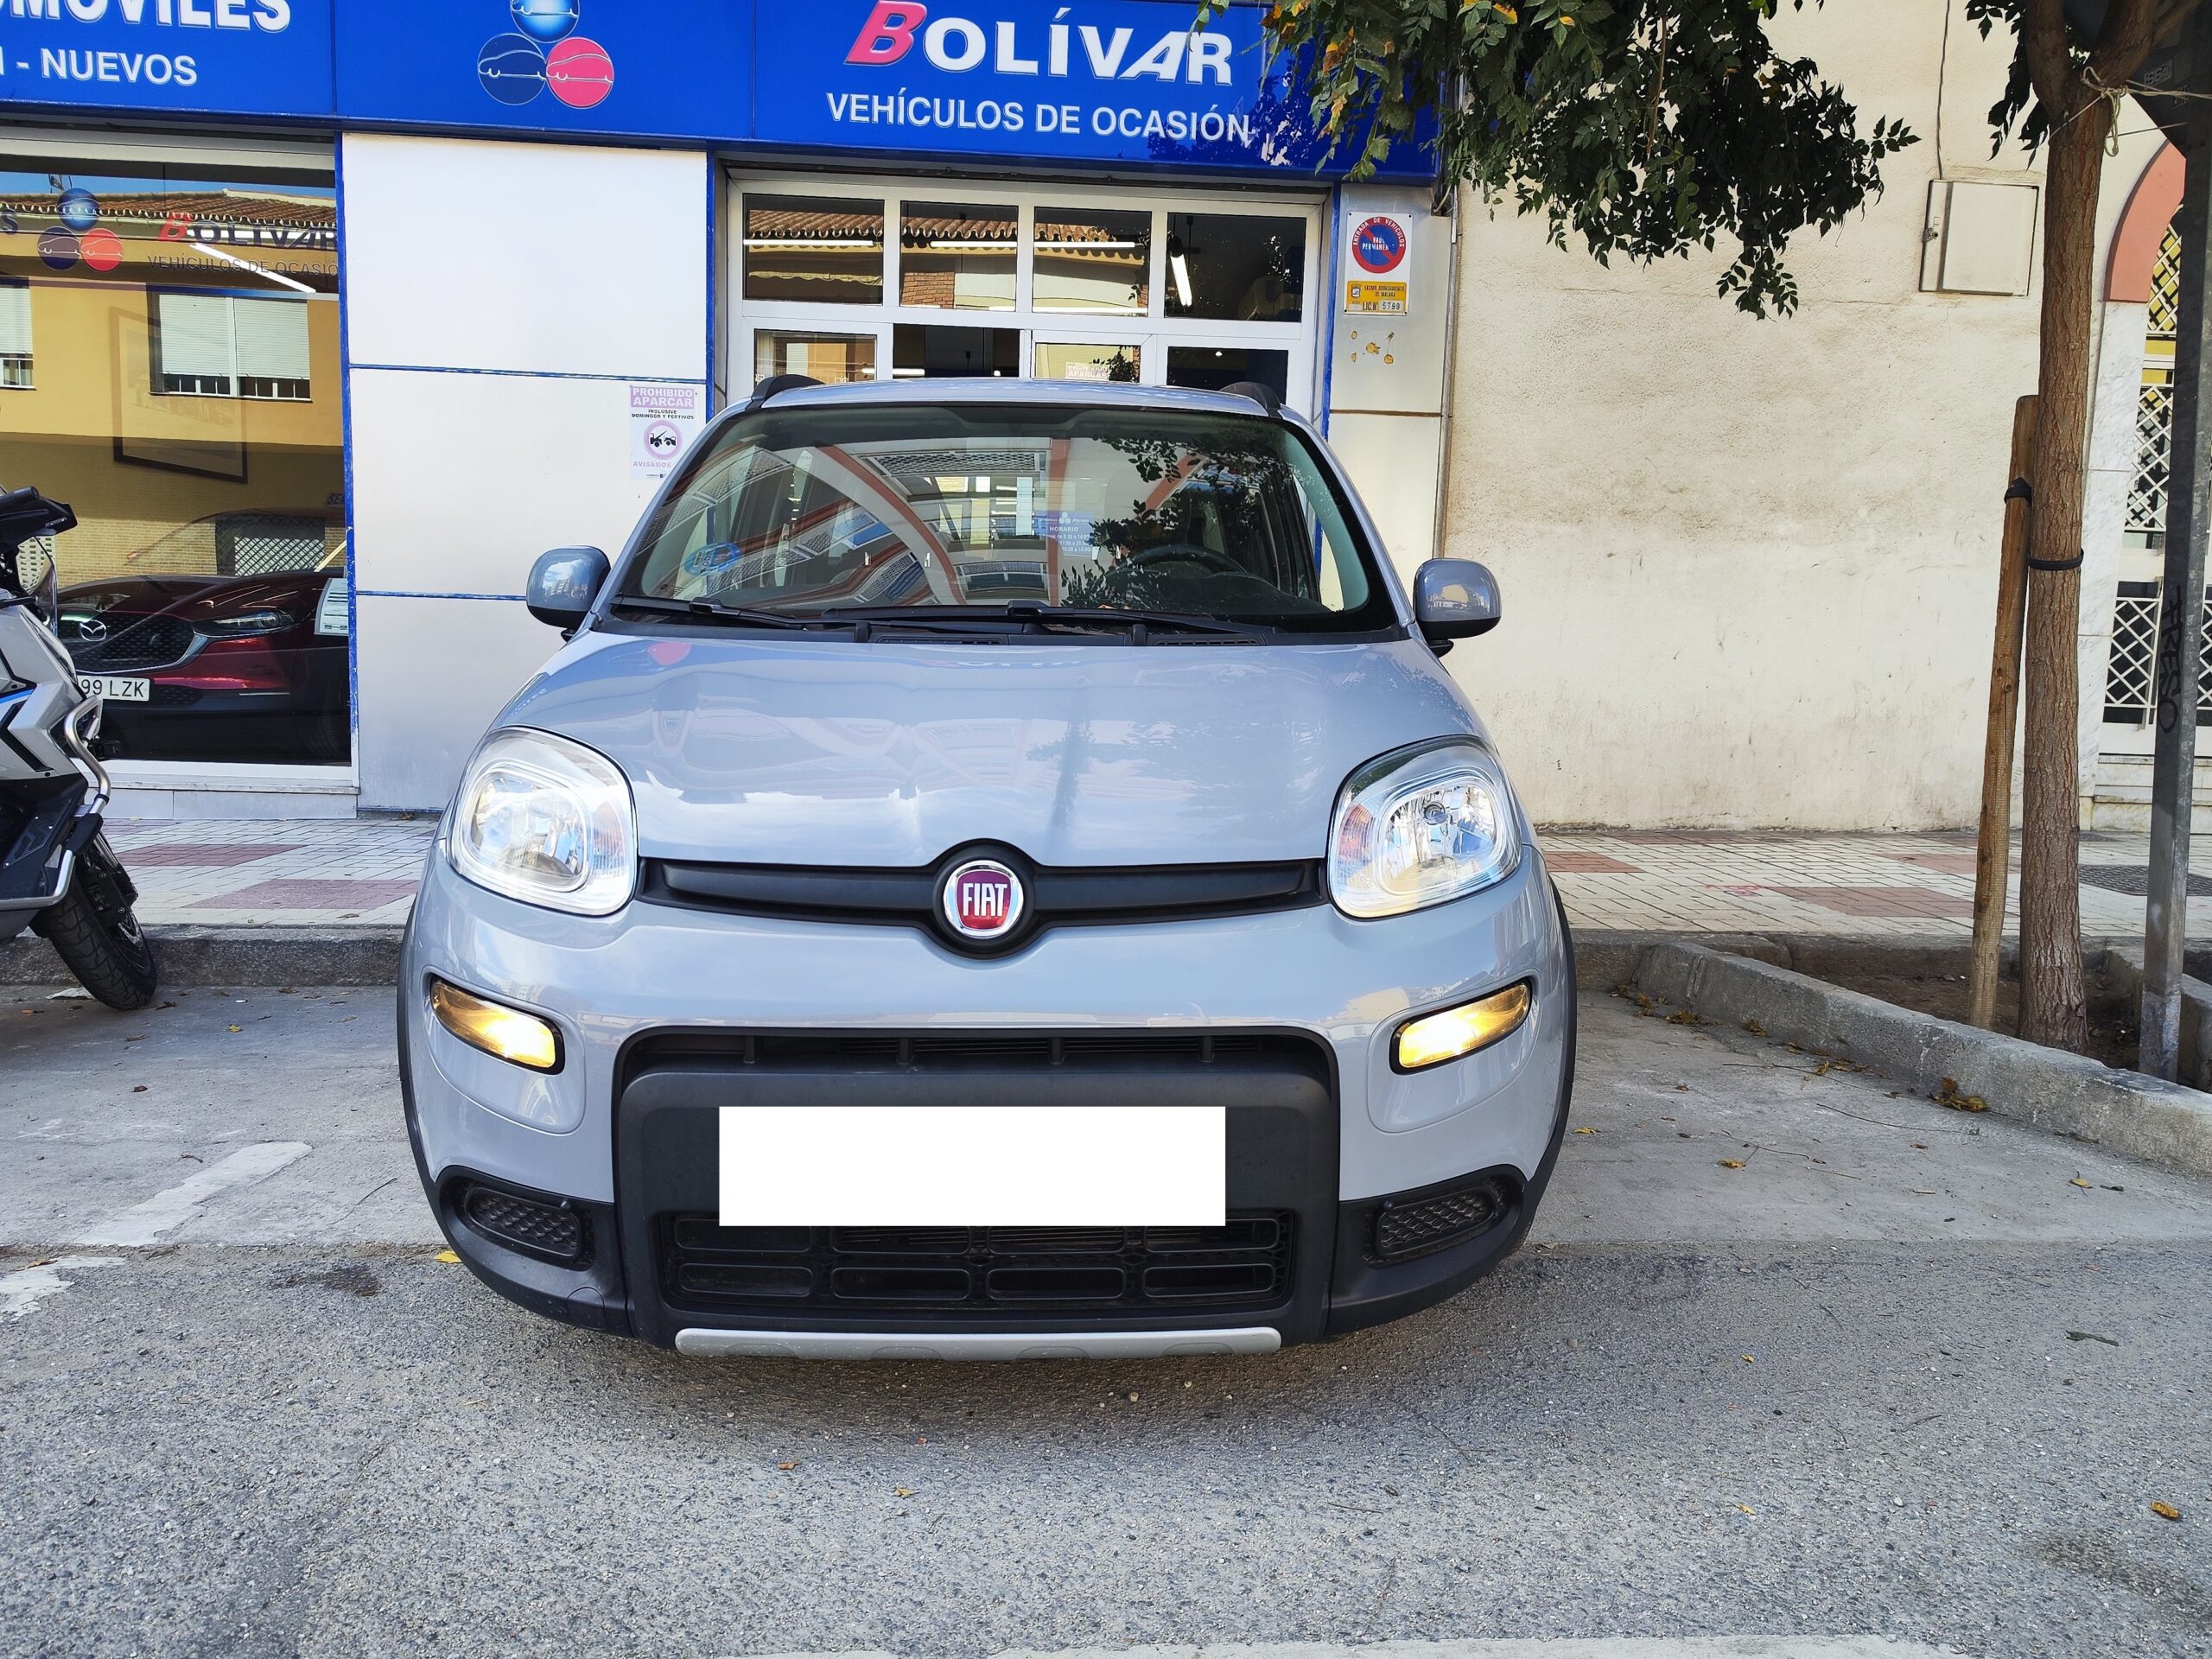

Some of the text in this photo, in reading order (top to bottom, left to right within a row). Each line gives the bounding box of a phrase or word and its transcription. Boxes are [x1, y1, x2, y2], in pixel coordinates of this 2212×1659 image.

[843, 0, 1233, 86] BOLÍVAR
[41, 48, 198, 86] NUEVOS
[826, 87, 1250, 143] VEHÍCULOS DE OCASIÓN
[249, 260, 269, 273] DE
[1382, 302, 1401, 310] 5798
[632, 387, 693, 398] PROHIBIDO
[632, 396, 693, 408] APARCAR
[110, 680, 144, 697] LZK
[963, 882, 1008, 917] FIAT
